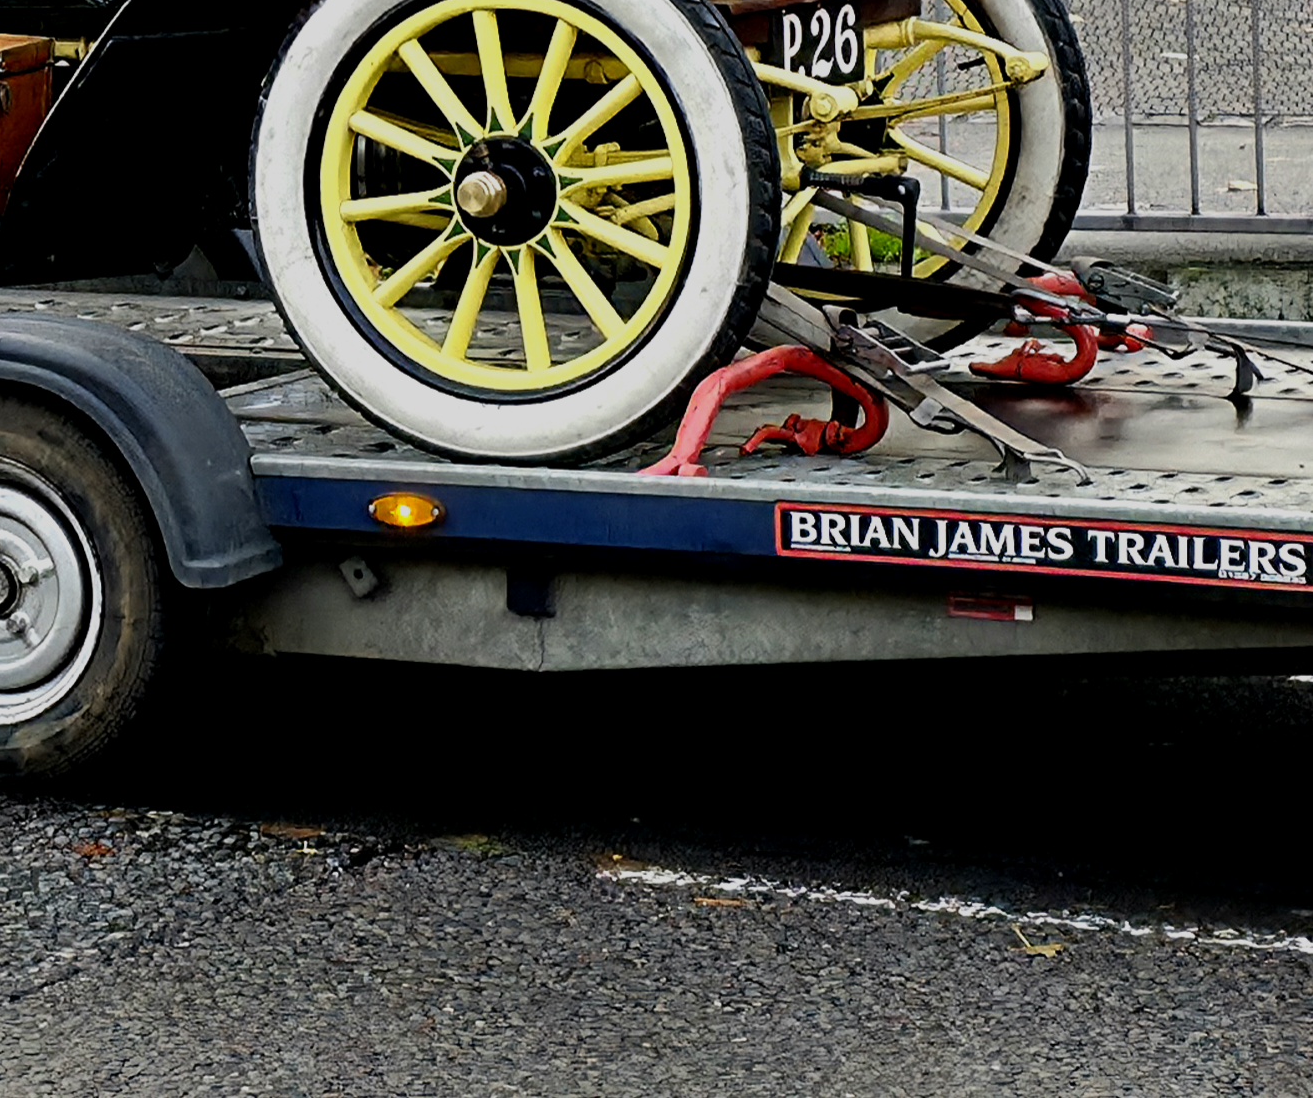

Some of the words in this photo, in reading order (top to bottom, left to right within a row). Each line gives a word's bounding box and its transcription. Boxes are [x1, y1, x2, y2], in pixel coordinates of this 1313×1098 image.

[789, 510, 921, 552] BRIAN
[927, 518, 1075, 562] JAMES
[1087, 528, 1307, 578] TRAILERS
